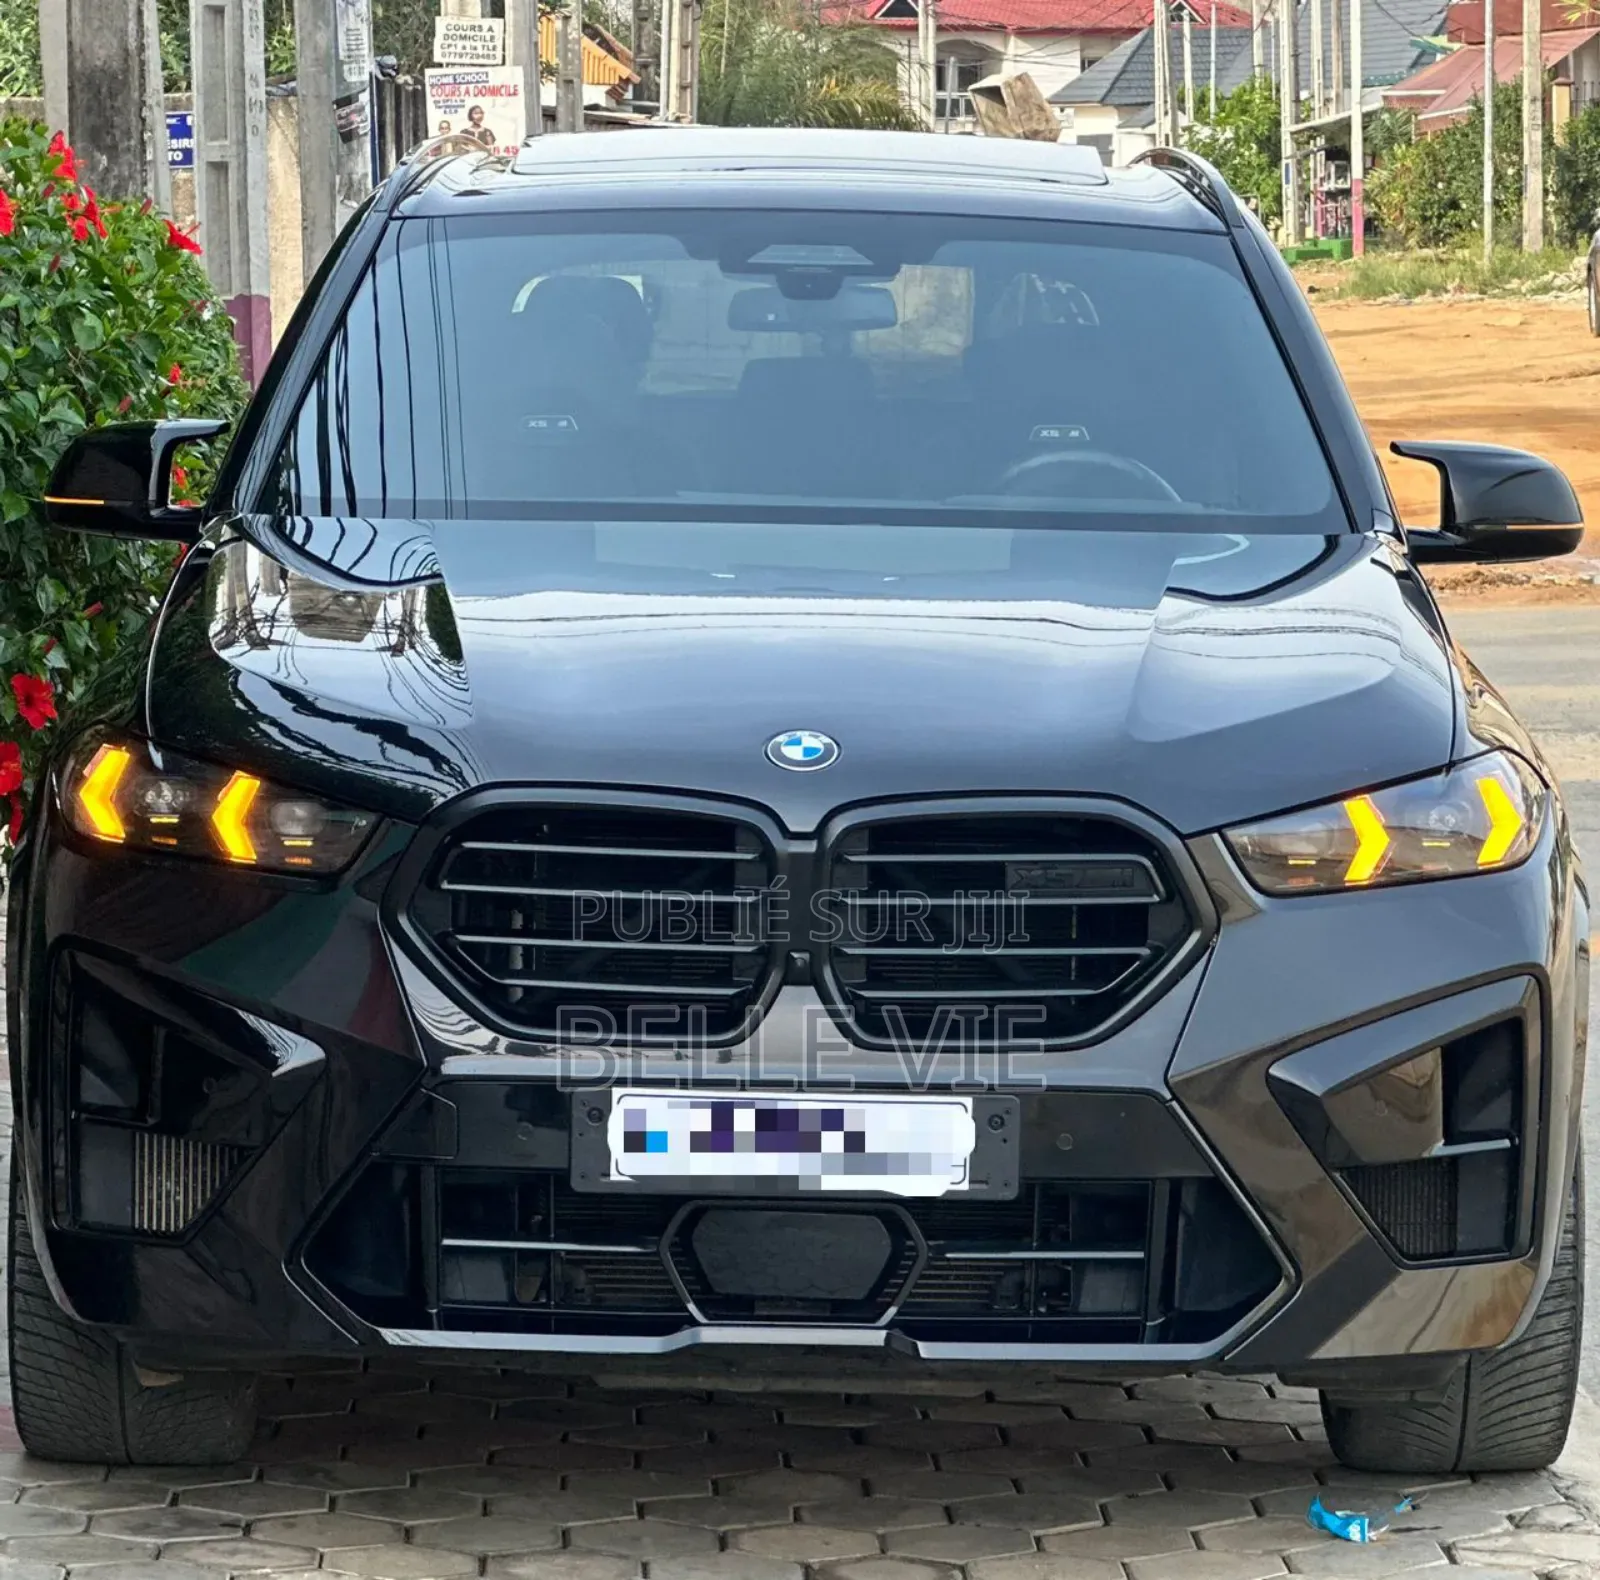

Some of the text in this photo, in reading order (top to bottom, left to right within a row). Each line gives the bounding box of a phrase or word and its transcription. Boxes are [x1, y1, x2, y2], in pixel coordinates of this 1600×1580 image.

[445, 23, 495, 33] COURS A
[443, 33, 496, 43] DOMICILE
[429, 72, 488, 85] HOME SCHOOL
[430, 84, 519, 97] COURS A DOMICILE
